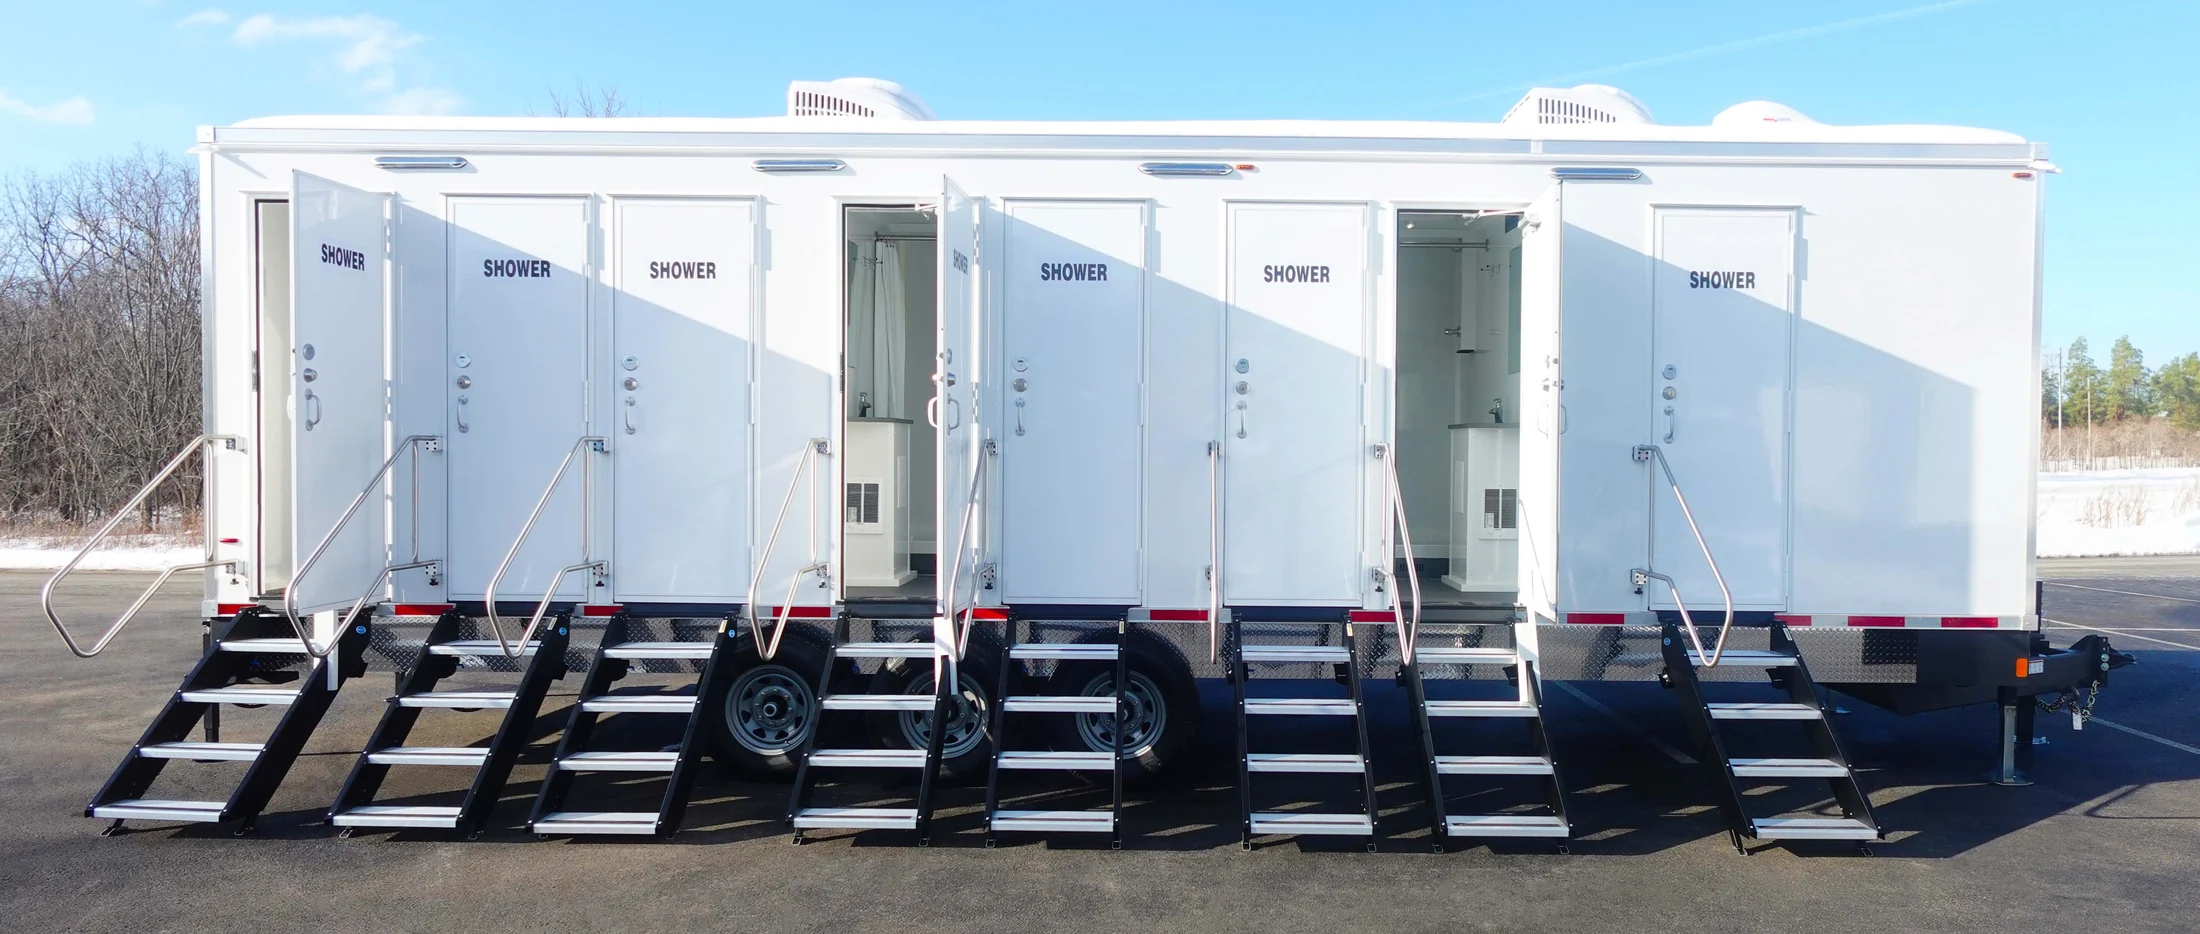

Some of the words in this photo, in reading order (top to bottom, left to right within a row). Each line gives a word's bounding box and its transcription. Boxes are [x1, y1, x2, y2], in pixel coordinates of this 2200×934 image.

[321, 243, 365, 272] SHOWER
[483, 259, 551, 278] SHOWER
[650, 262, 716, 279] SHOWER
[1041, 262, 1107, 281] SHOWER
[1264, 265, 1330, 282] SHOWER
[1690, 271, 1755, 289] SHOWER
